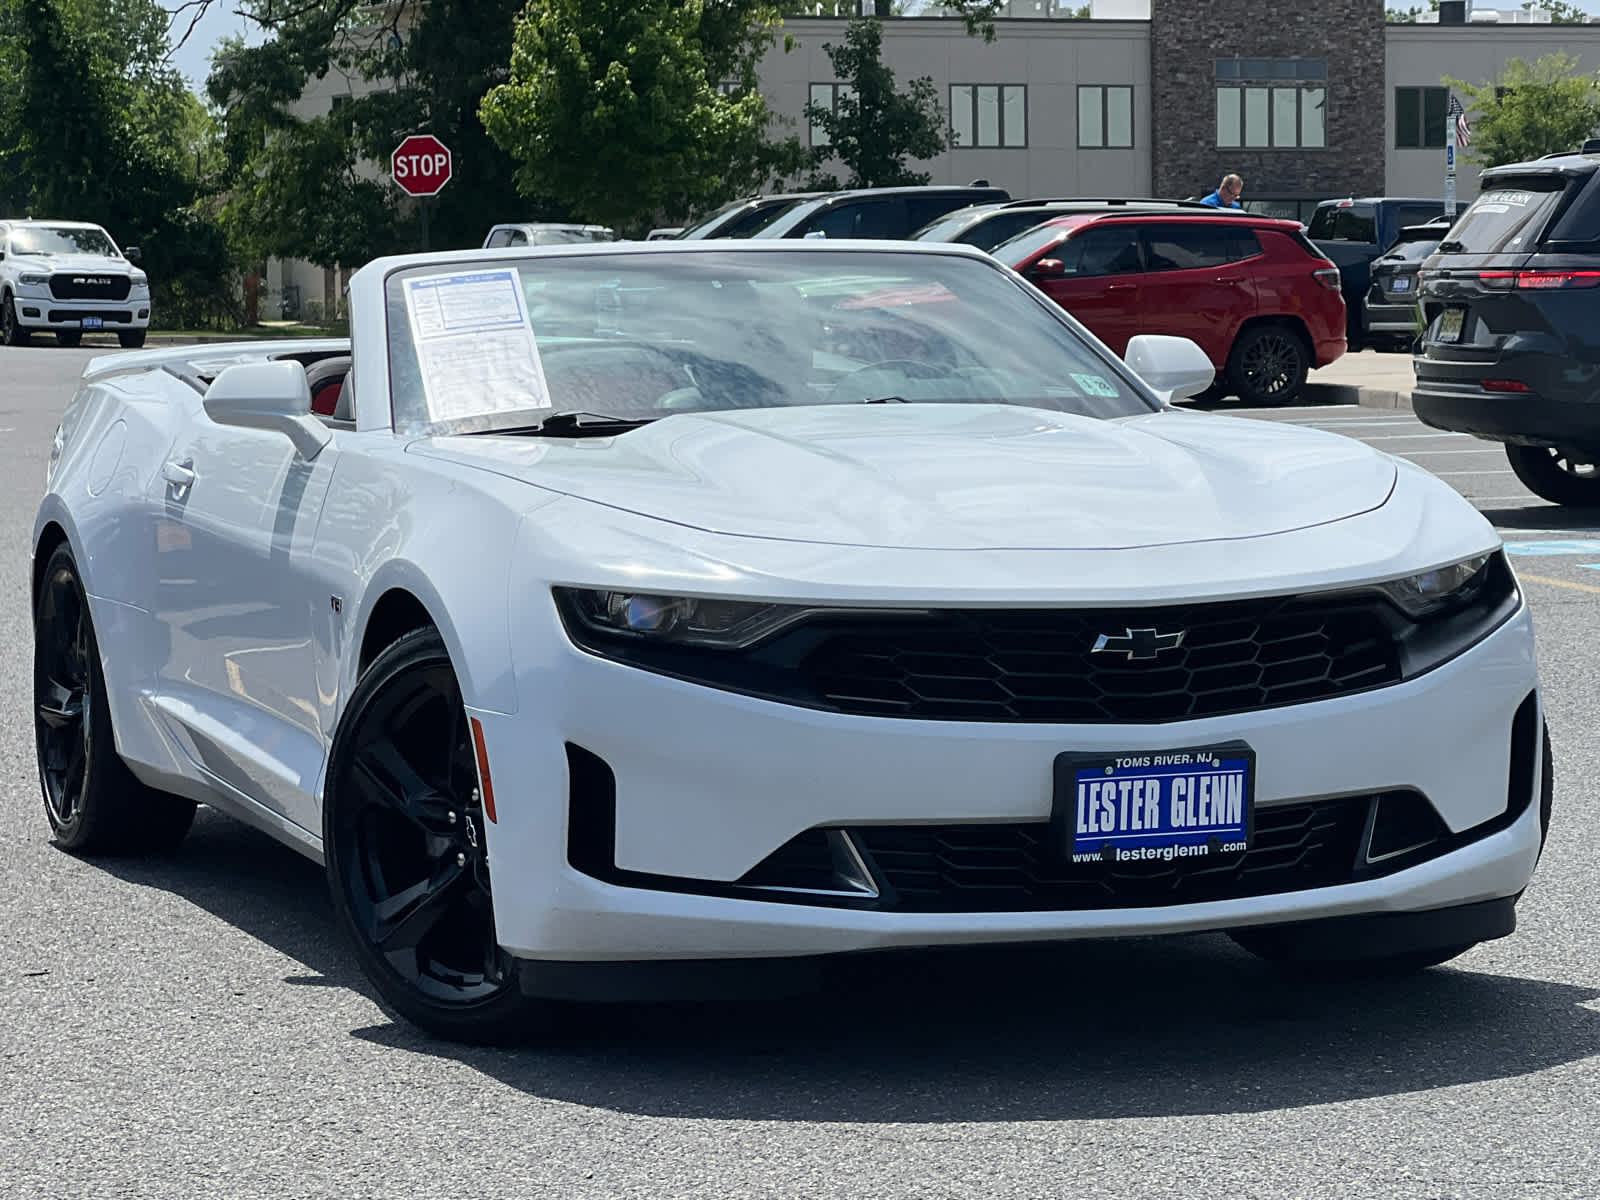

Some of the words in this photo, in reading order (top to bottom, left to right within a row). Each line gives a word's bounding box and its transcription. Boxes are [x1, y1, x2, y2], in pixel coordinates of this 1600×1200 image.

[396, 153, 447, 178] STOP
[1116, 757, 1150, 768] TOMS
[1154, 754, 1194, 766] RIVER,
[1197, 753, 1213, 763] NJ
[1076, 779, 1160, 834] LESTER
[1170, 774, 1243, 828] GLENN
[1073, 853, 1103, 863] www.
[1116, 844, 1209, 862] lesterglenn
[1220, 841, 1247, 852] .com
